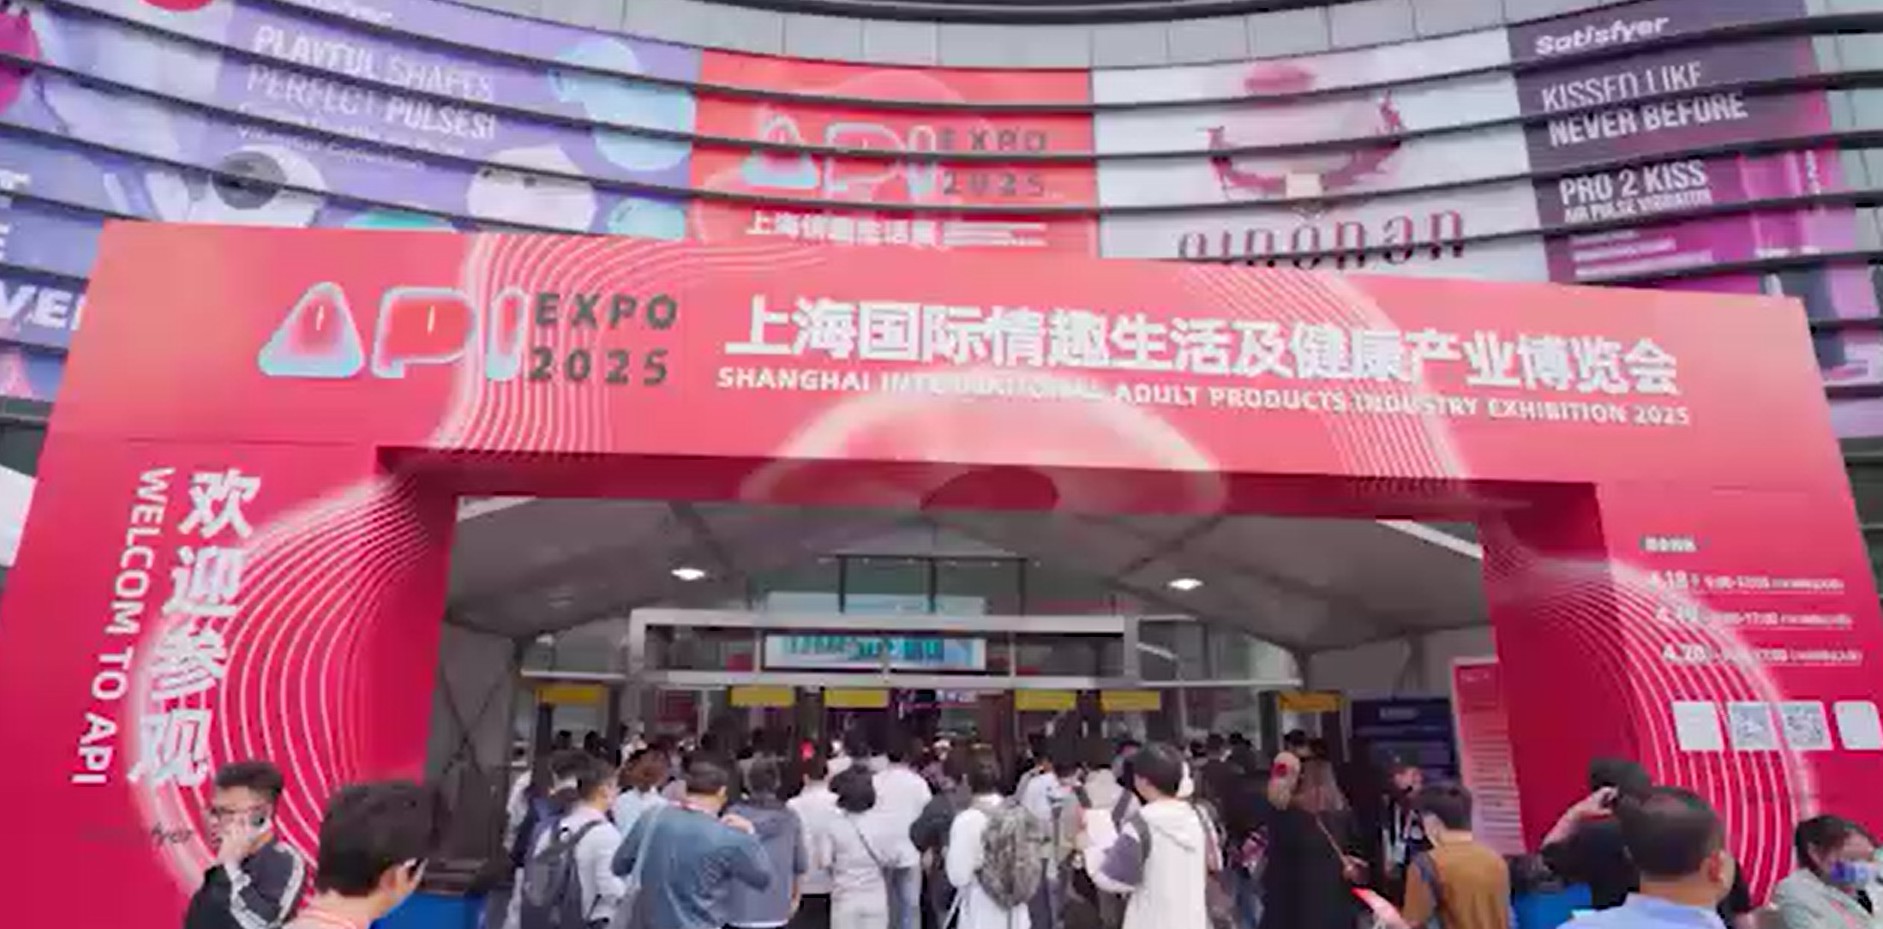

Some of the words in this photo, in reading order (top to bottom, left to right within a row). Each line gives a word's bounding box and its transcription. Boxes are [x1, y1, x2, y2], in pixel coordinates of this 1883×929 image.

[1535, 17, 1669, 56] Satisfyer
[1541, 71, 1638, 113] KISSED
[1648, 61, 1702, 99] LIKE
[939, 127, 1047, 153] EXPO
[1549, 108, 1637, 147] NEVER
[1643, 92, 1748, 136] BEFORE
[943, 171, 1045, 197] 2025
[1559, 174, 1613, 206] PRO
[1617, 168, 1640, 198] 2
[1643, 159, 1709, 193] KISS
[258, 281, 529, 382] API
[535, 291, 678, 331] EXPO
[528, 346, 669, 386] 2025
[725, 294, 1679, 395] 上海国际情趣生活及健康产业博览会
[716, 365, 870, 392] SHANGHAI
[1113, 382, 1199, 408] ADULT
[1209, 385, 1347, 413] PRODUCTS
[1352, 391, 1478, 417] INDUSTRY
[1487, 397, 1628, 424] EXHIBITION
[1633, 405, 1690, 427] 2025
[105, 467, 175, 636] WELCOM
[127, 468, 261, 789] 欢迎参观
[91, 644, 138, 702] TO
[70, 711, 119, 786] API
